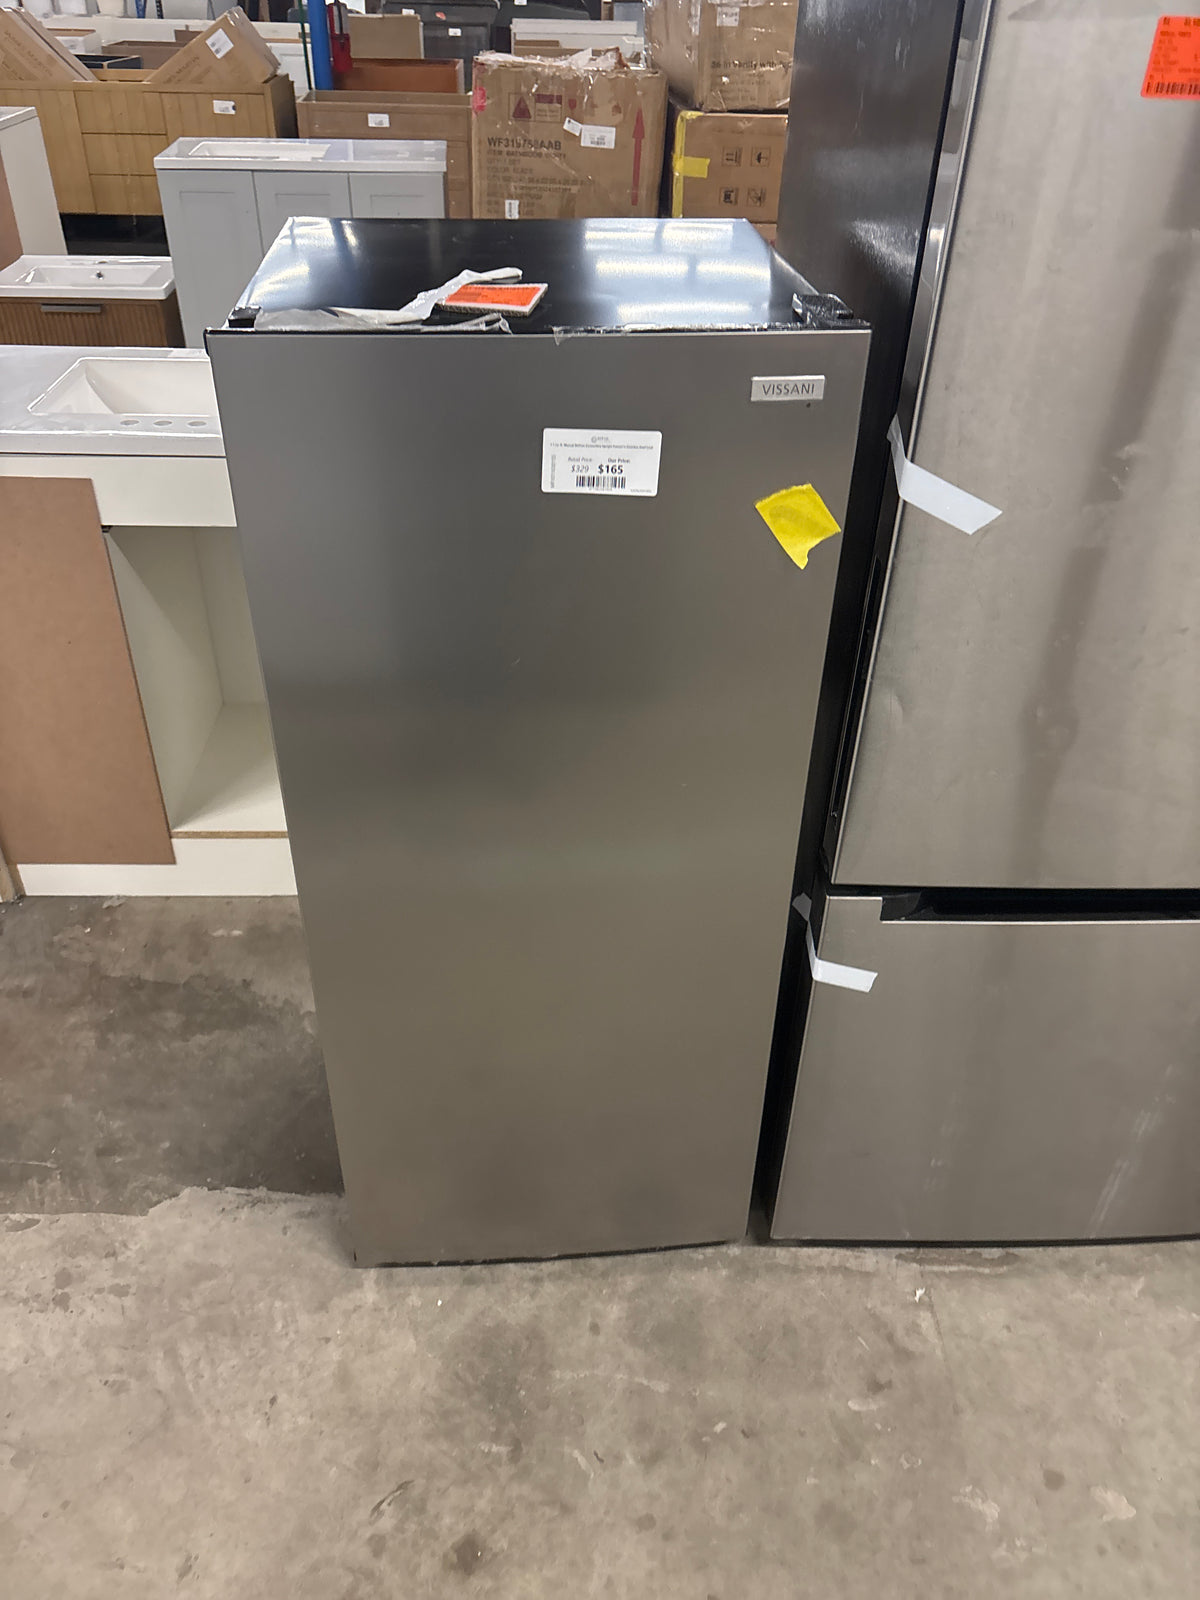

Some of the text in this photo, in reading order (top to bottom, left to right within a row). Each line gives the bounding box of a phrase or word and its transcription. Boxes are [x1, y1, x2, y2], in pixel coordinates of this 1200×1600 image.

[762, 383, 815, 396] VISSANI
[571, 464, 590, 473] $329
[598, 464, 623, 475] $165
